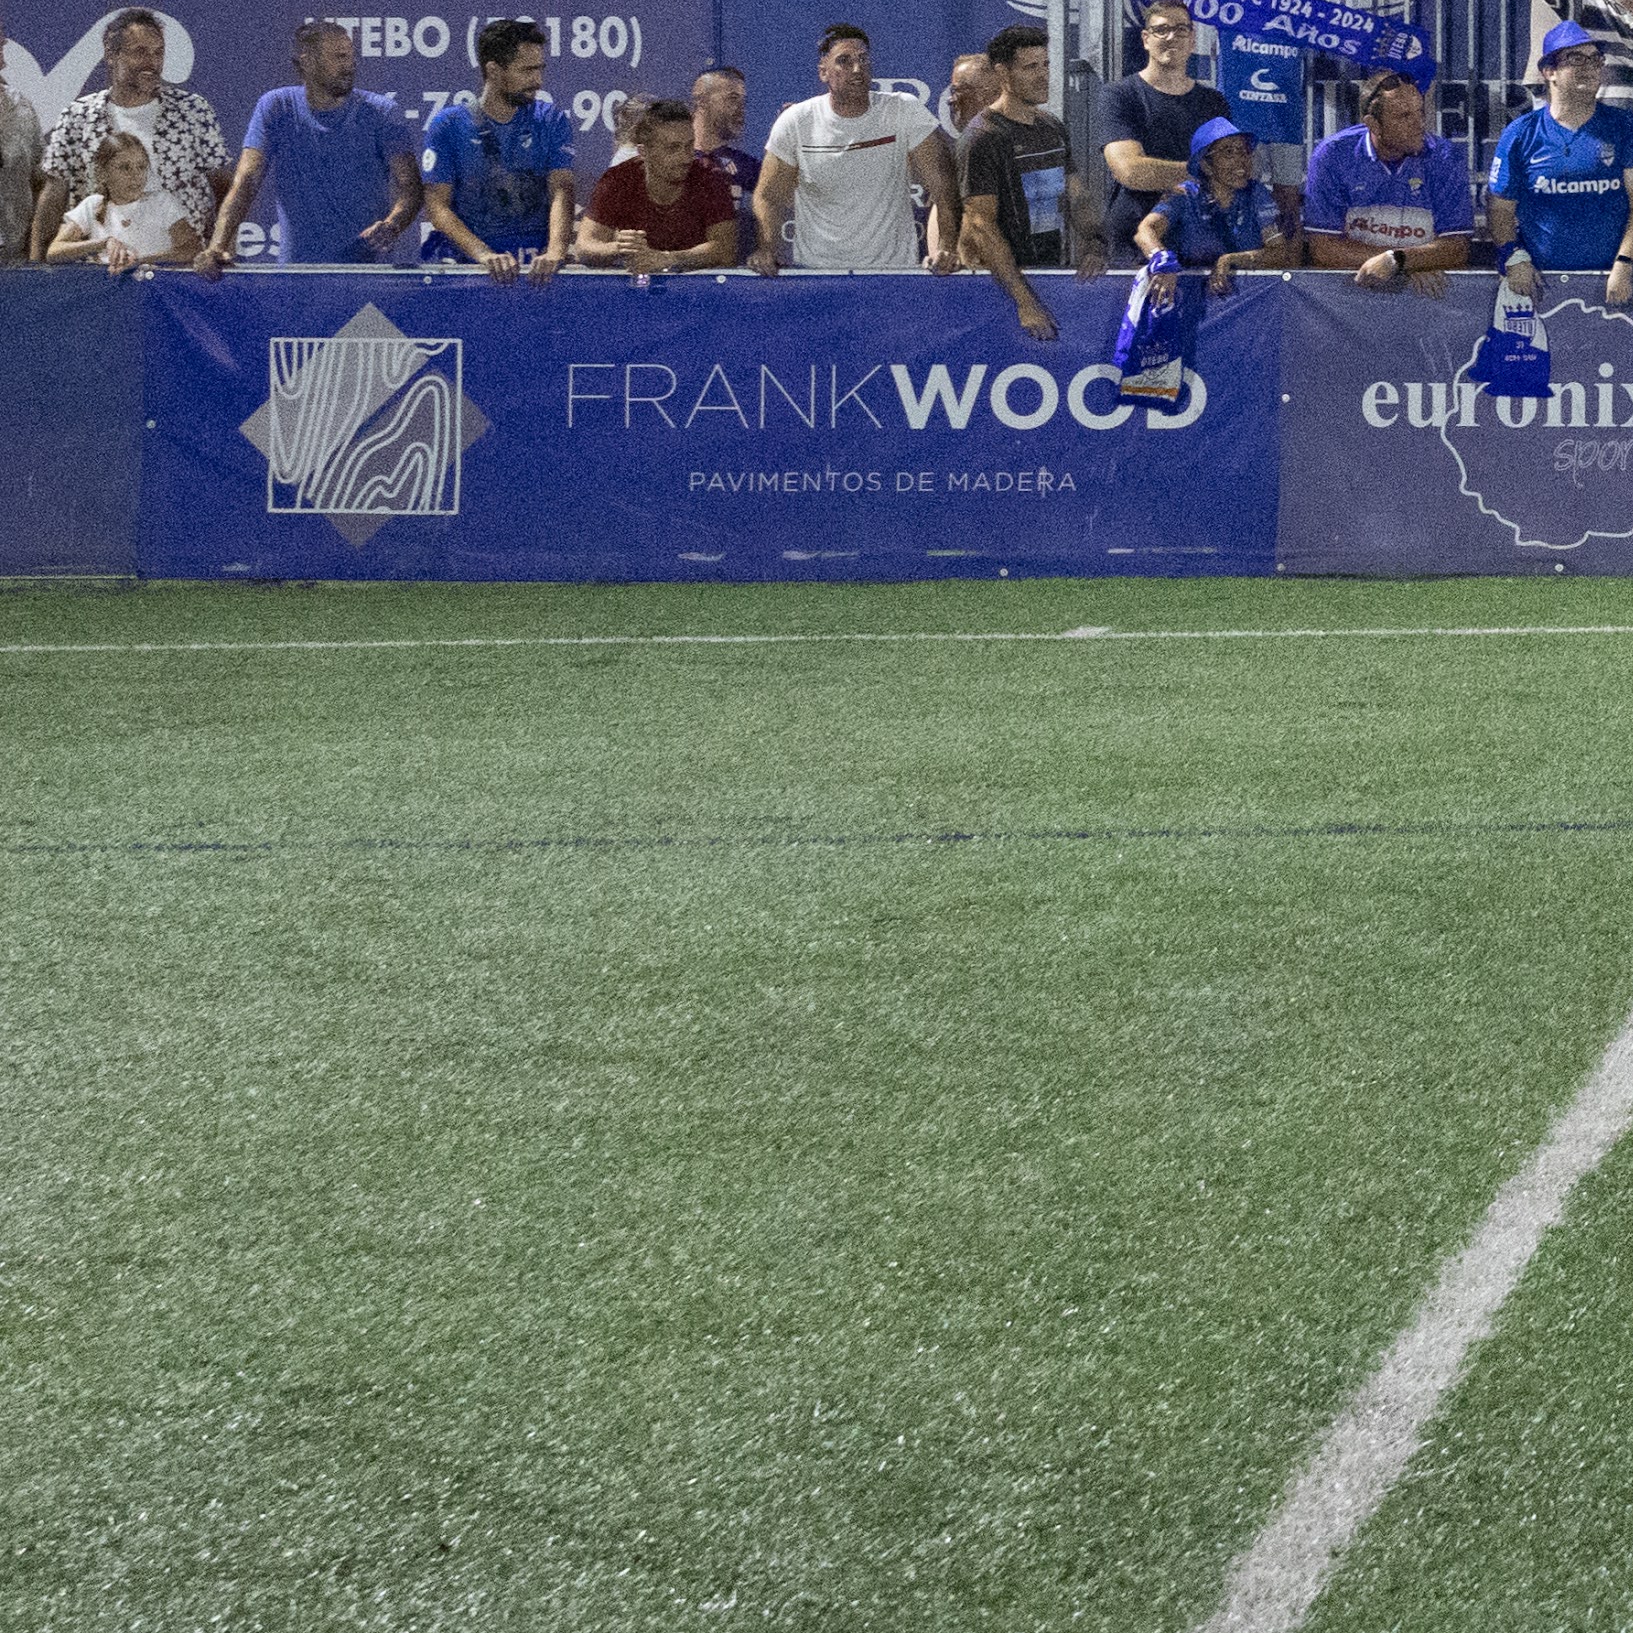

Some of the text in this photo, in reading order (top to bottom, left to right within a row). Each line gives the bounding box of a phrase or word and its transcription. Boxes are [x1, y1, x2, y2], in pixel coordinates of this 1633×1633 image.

[1329, 9, 1375, 34] 2024
[466, 15, 643, 69] (180)
[1231, 34, 1299, 59] Alcampo
[1534, 174, 1621, 195] Alcampo
[1349, 216, 1426, 239] Alcampo
[688, 471, 1077, 493] PAVIMENTOS DE MADERA
